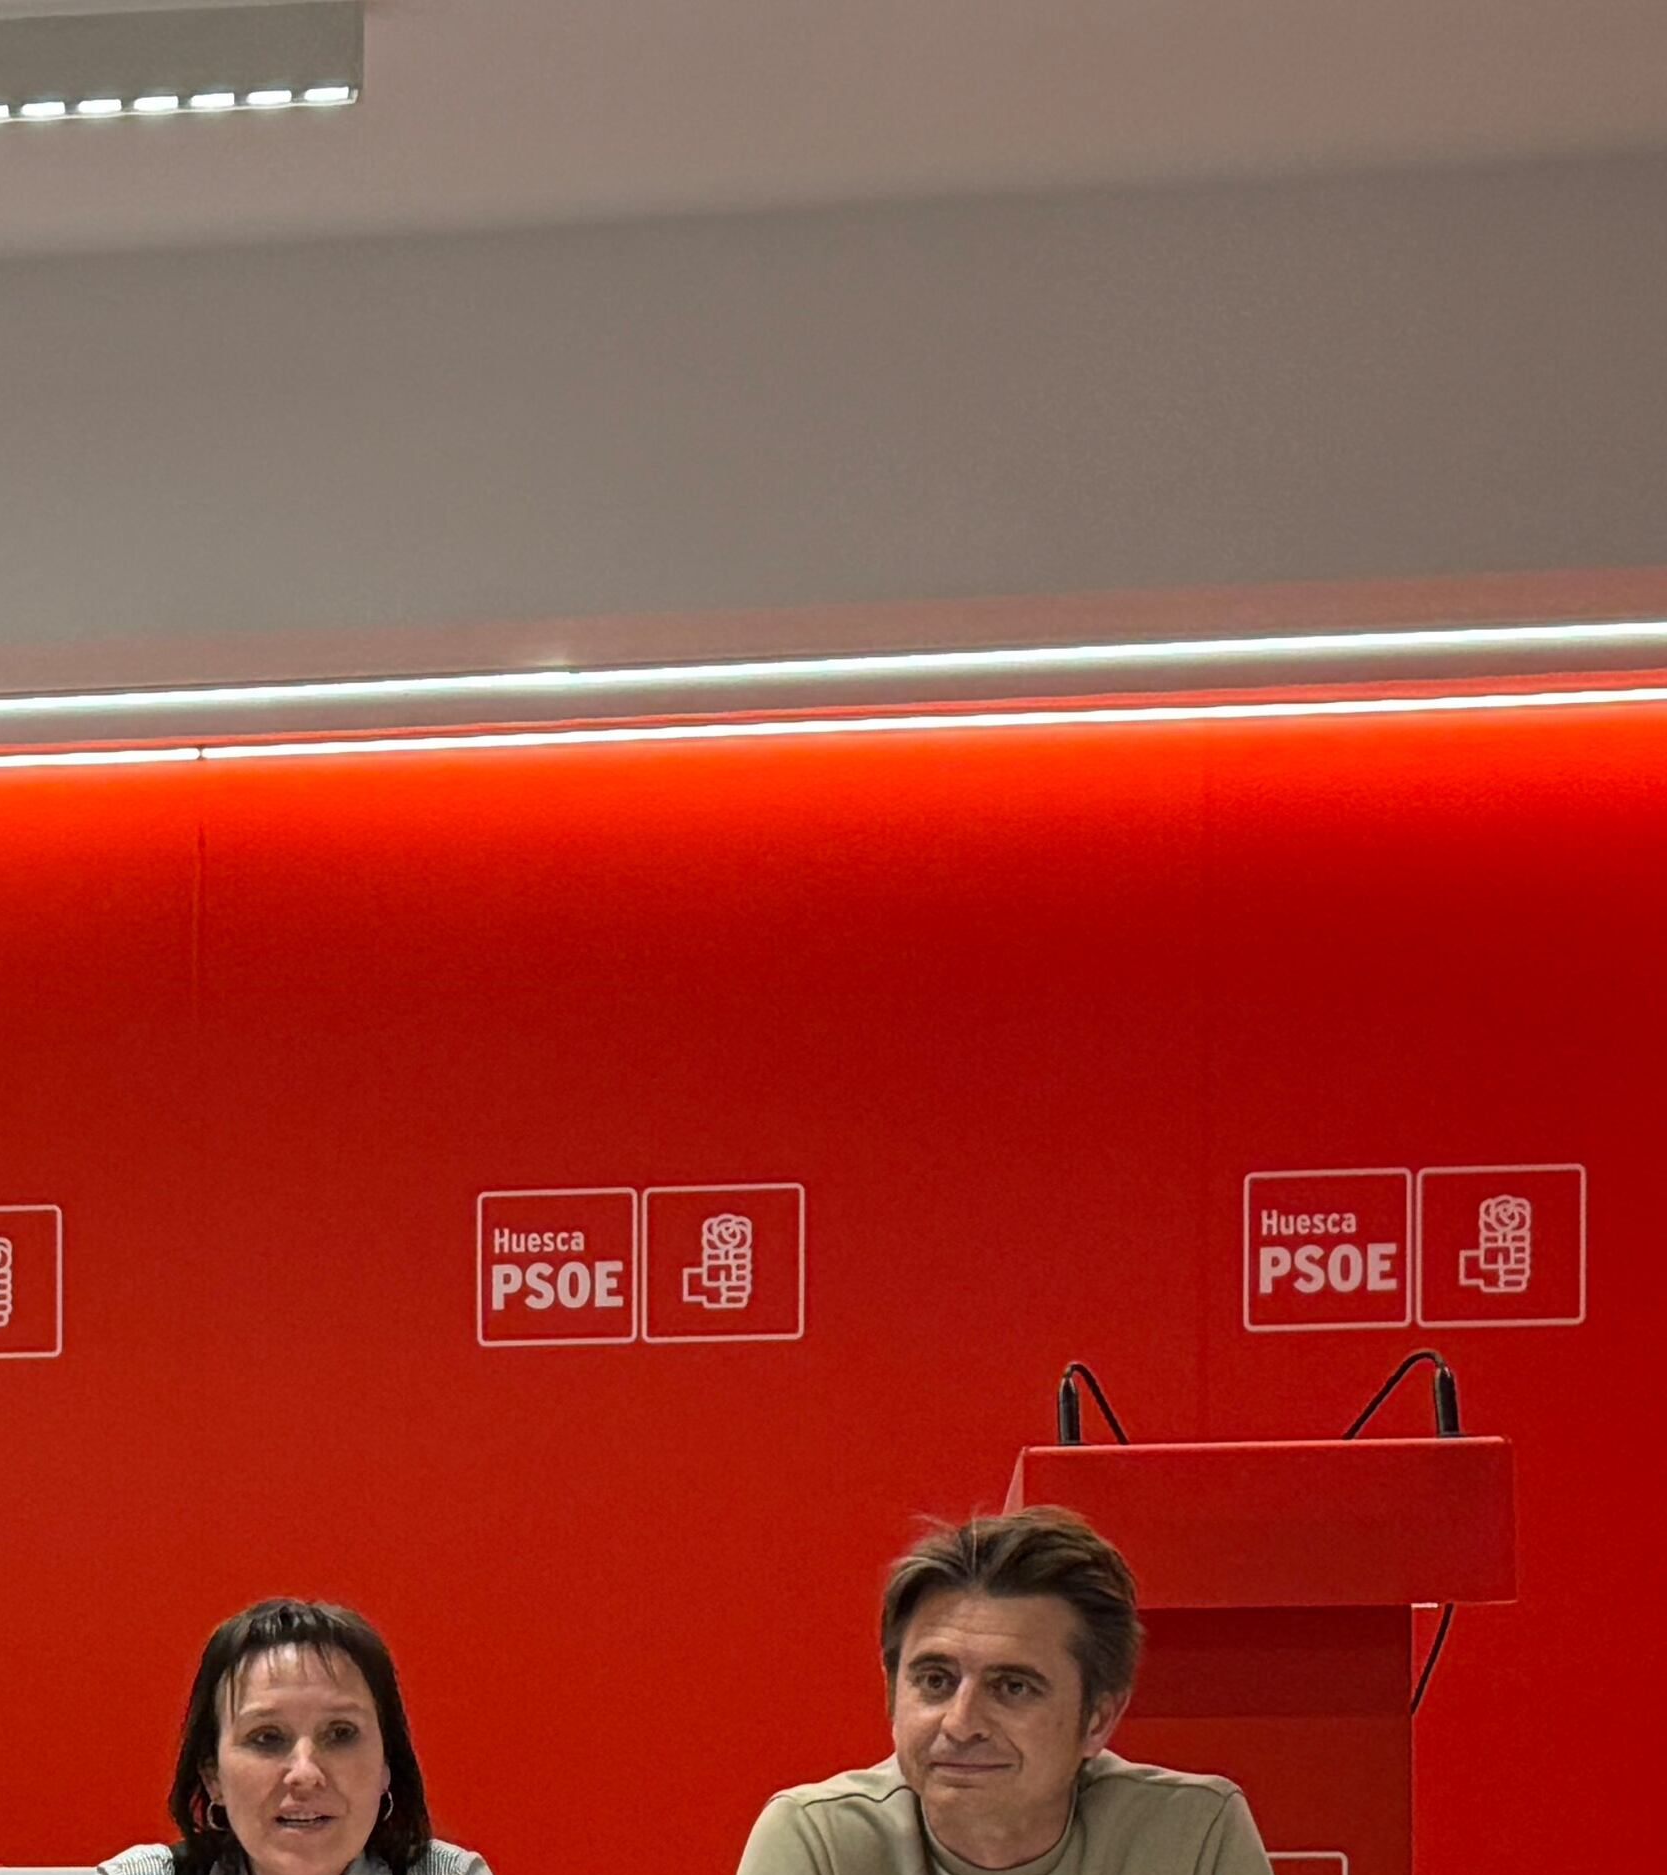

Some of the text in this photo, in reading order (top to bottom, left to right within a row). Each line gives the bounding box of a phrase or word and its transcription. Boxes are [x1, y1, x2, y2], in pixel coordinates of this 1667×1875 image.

[494, 1228, 585, 1254] Huesca
[1261, 1209, 1357, 1236] Huesca
[492, 1261, 624, 1310] PSOE
[1259, 1243, 1399, 1294] PSOE
